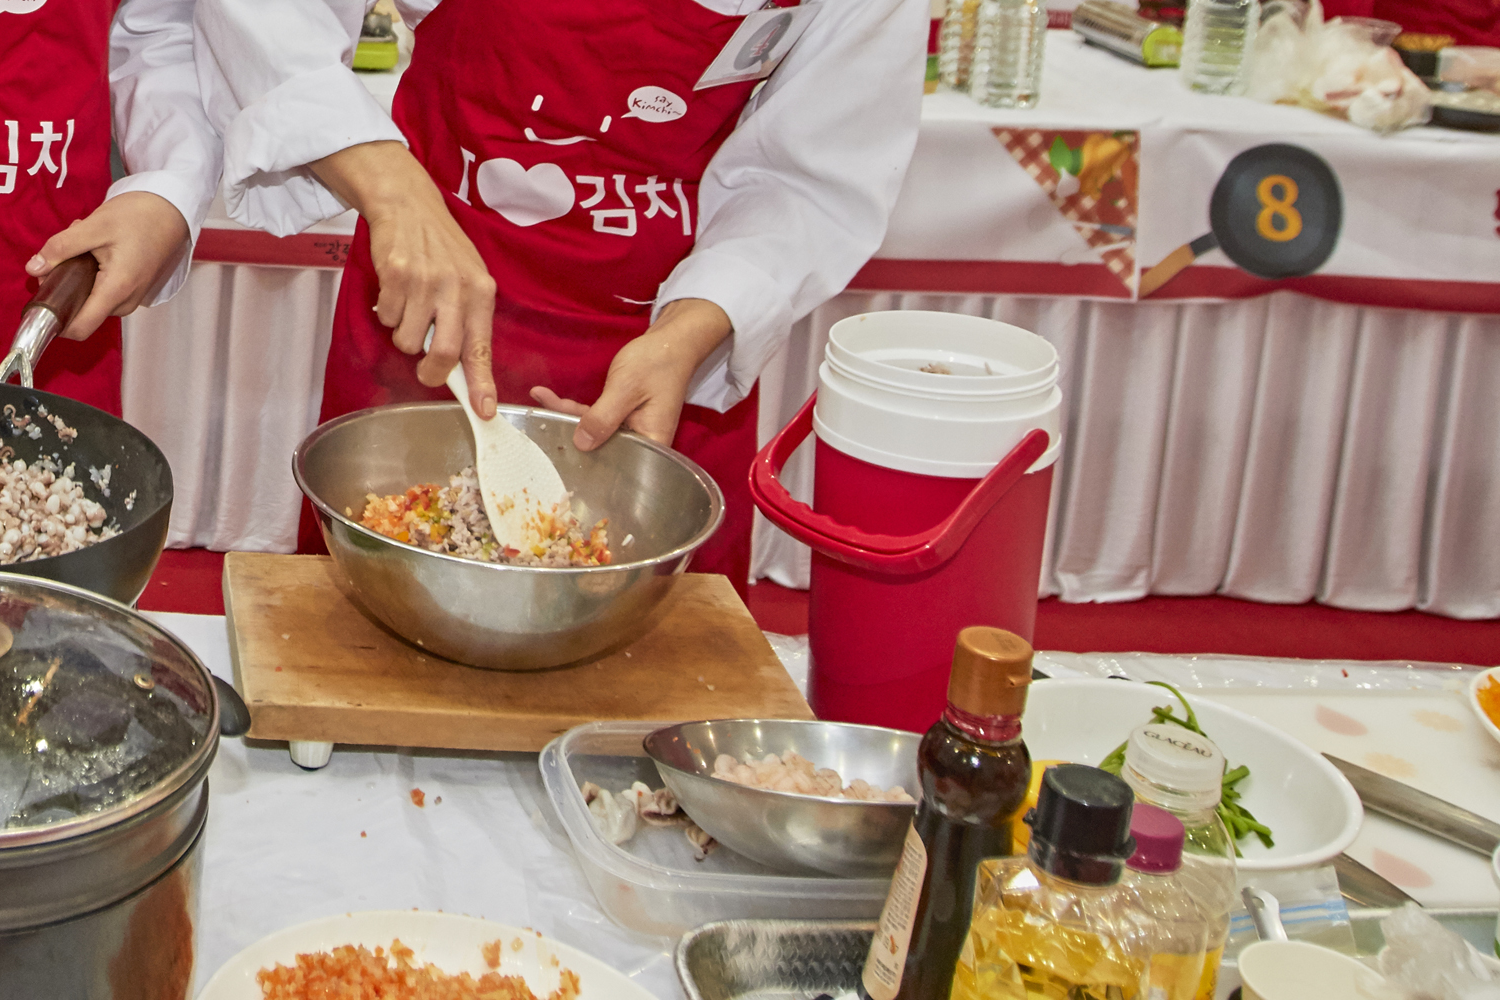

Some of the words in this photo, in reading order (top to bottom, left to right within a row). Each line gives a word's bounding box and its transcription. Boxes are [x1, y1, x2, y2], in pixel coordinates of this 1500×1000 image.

[654, 95, 673, 108] say
[575, 174, 692, 237] 김치
[1255, 173, 1303, 242] 8
